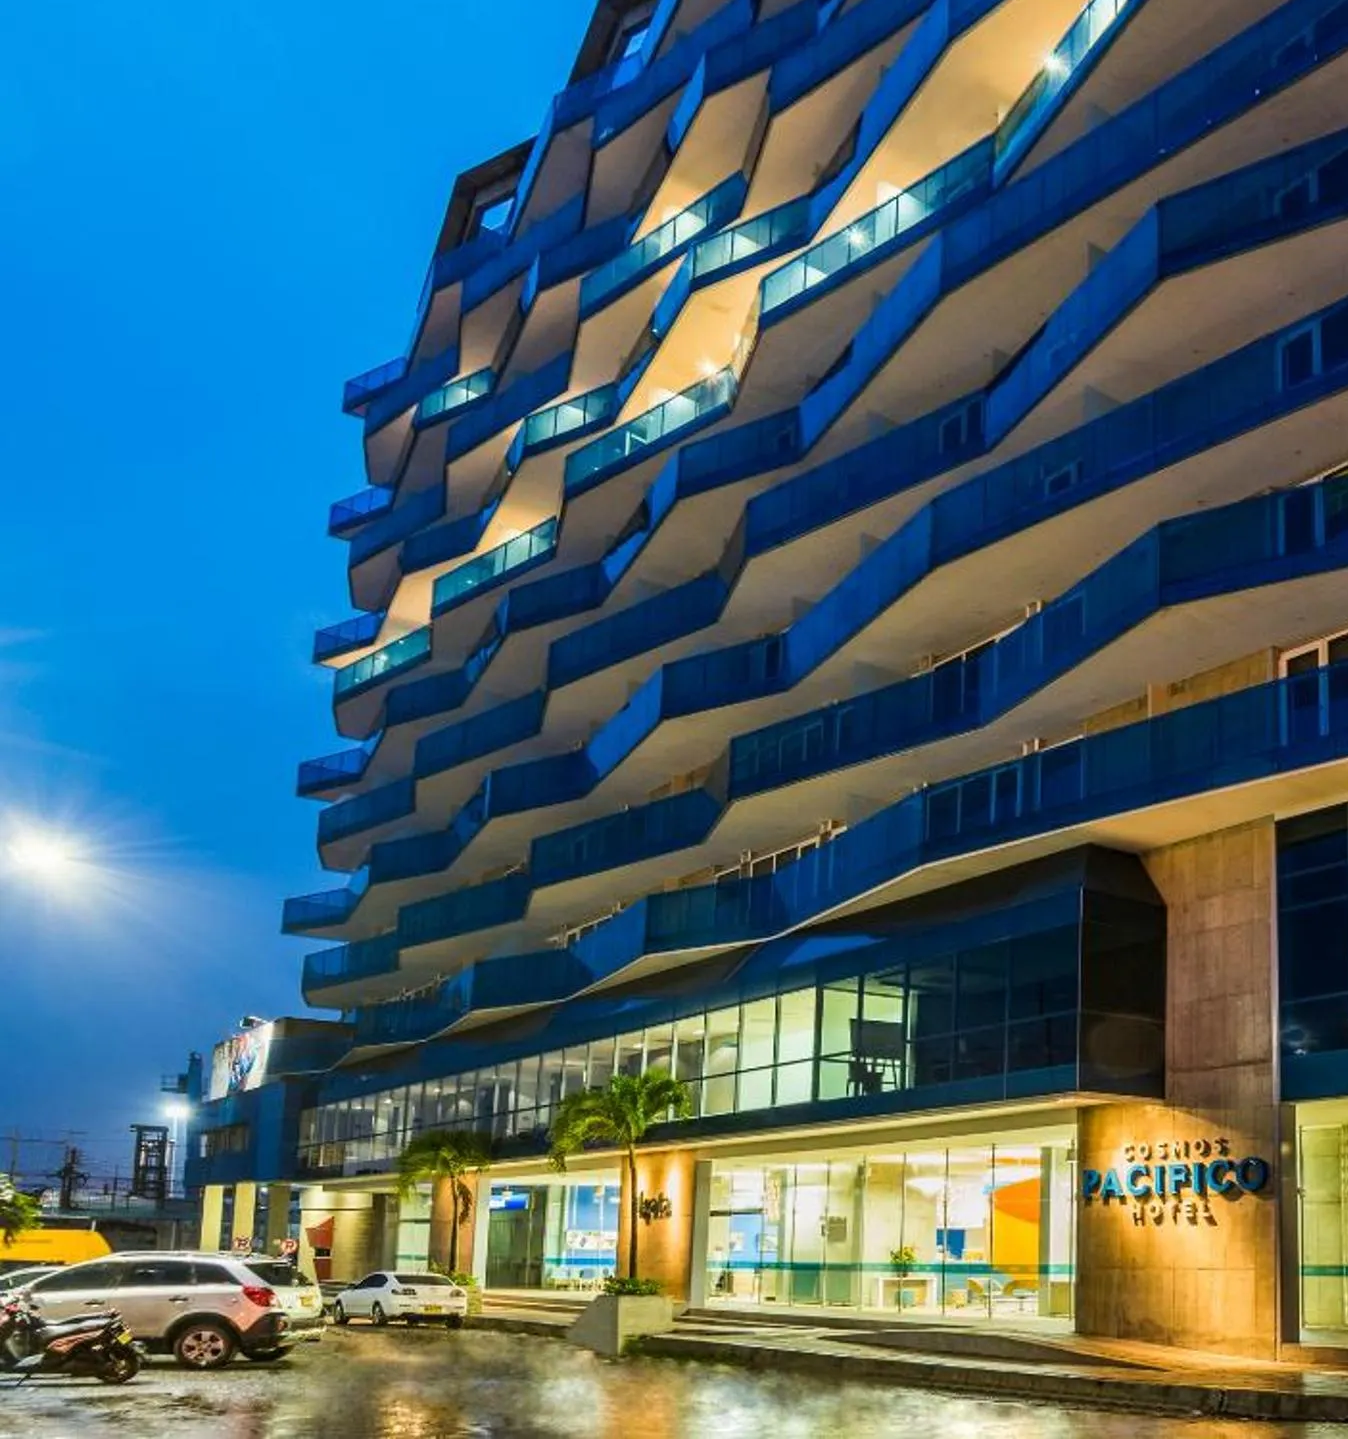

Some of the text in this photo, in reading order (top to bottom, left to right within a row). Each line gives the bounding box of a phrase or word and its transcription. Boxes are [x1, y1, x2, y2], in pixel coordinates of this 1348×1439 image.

[1123, 1137, 1229, 1162] COSMOS
[1082, 1156, 1269, 1201] PACIFICO
[1131, 1199, 1216, 1225] HOTEL
